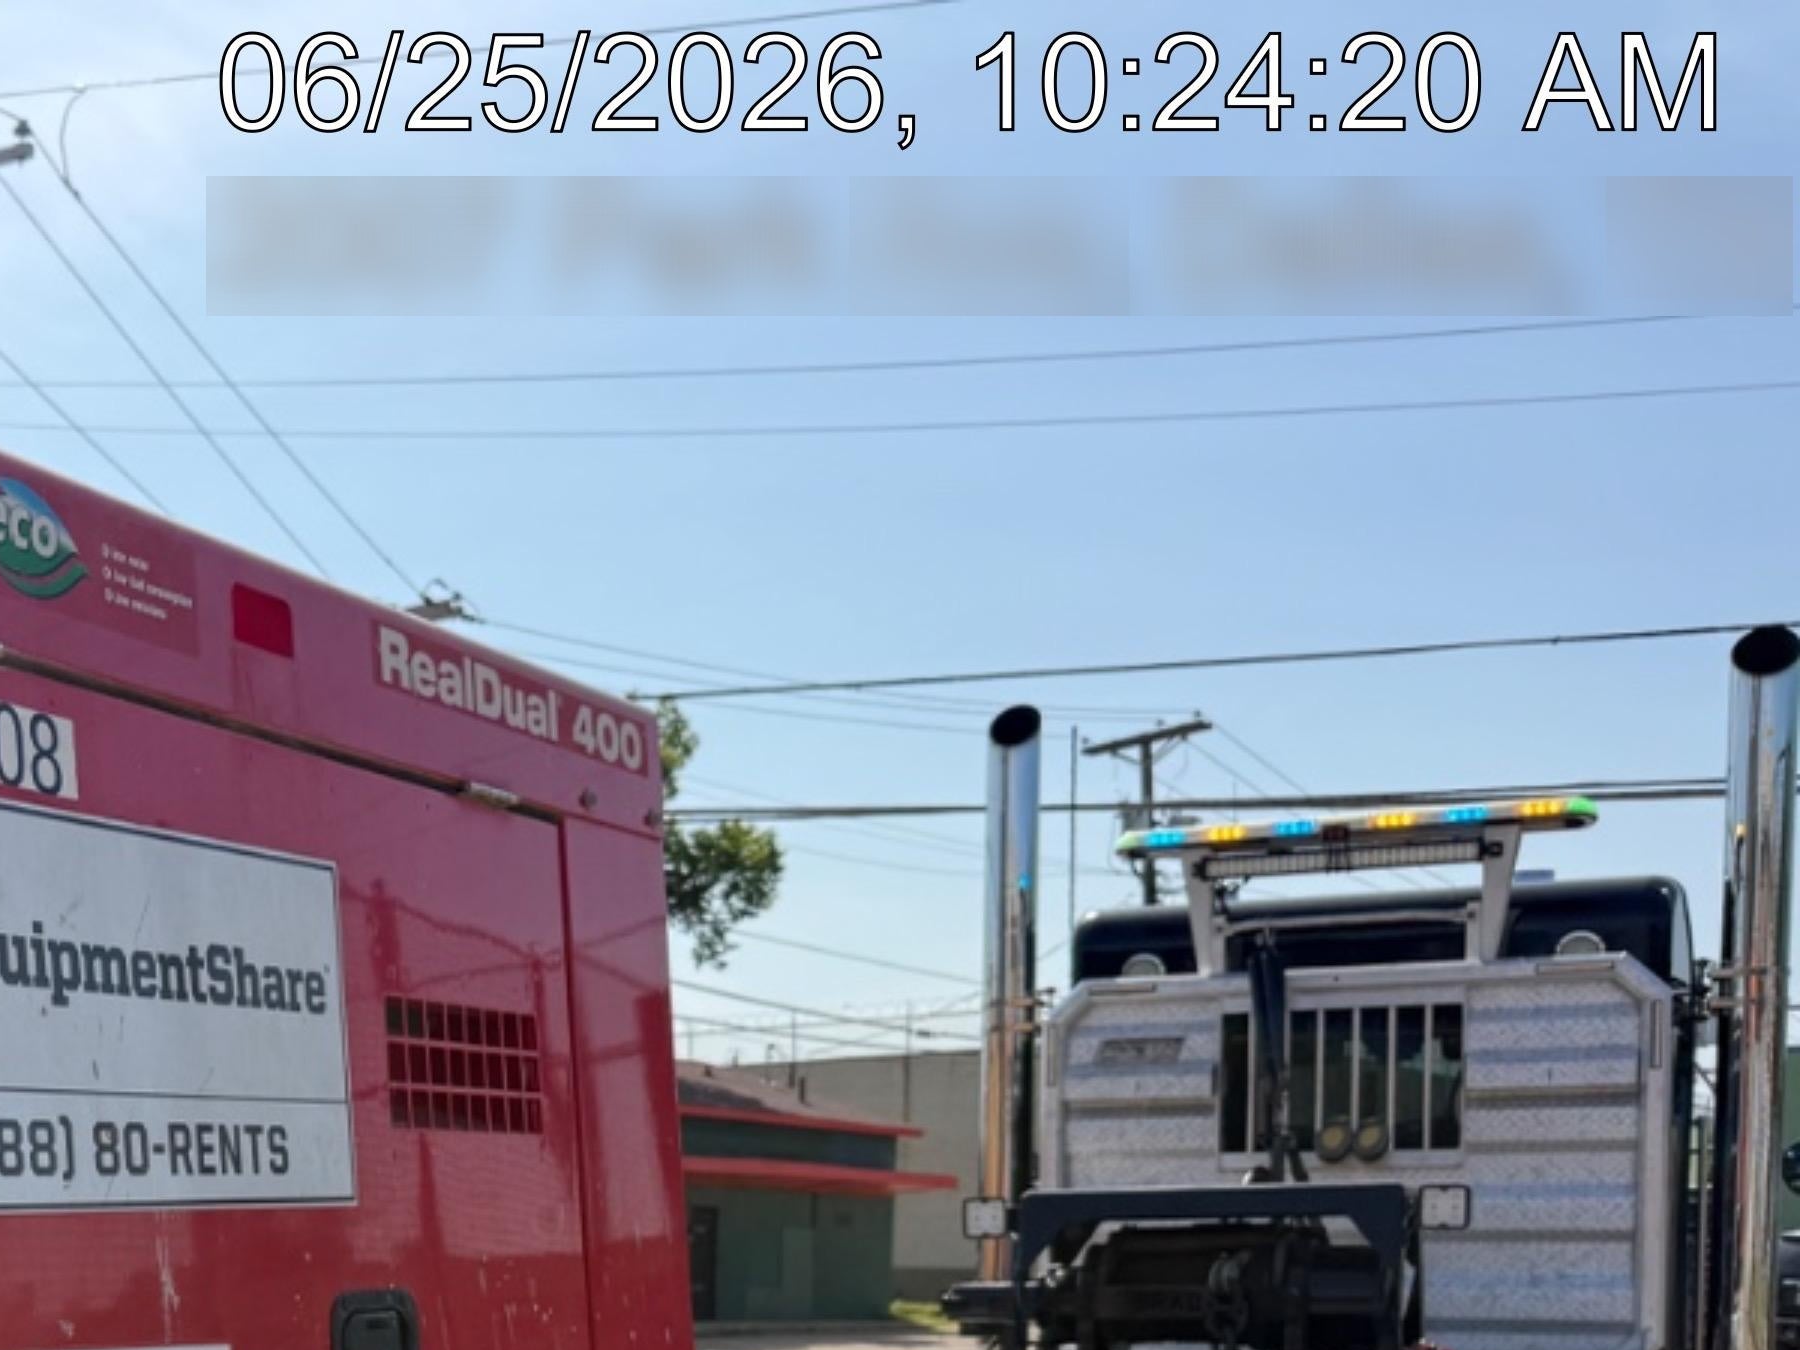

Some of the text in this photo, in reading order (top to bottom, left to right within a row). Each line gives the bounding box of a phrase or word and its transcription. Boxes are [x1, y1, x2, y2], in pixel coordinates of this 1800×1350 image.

[378, 626, 643, 769] RealDual 400
[93, 1121, 289, 1175] 80-RENTS
